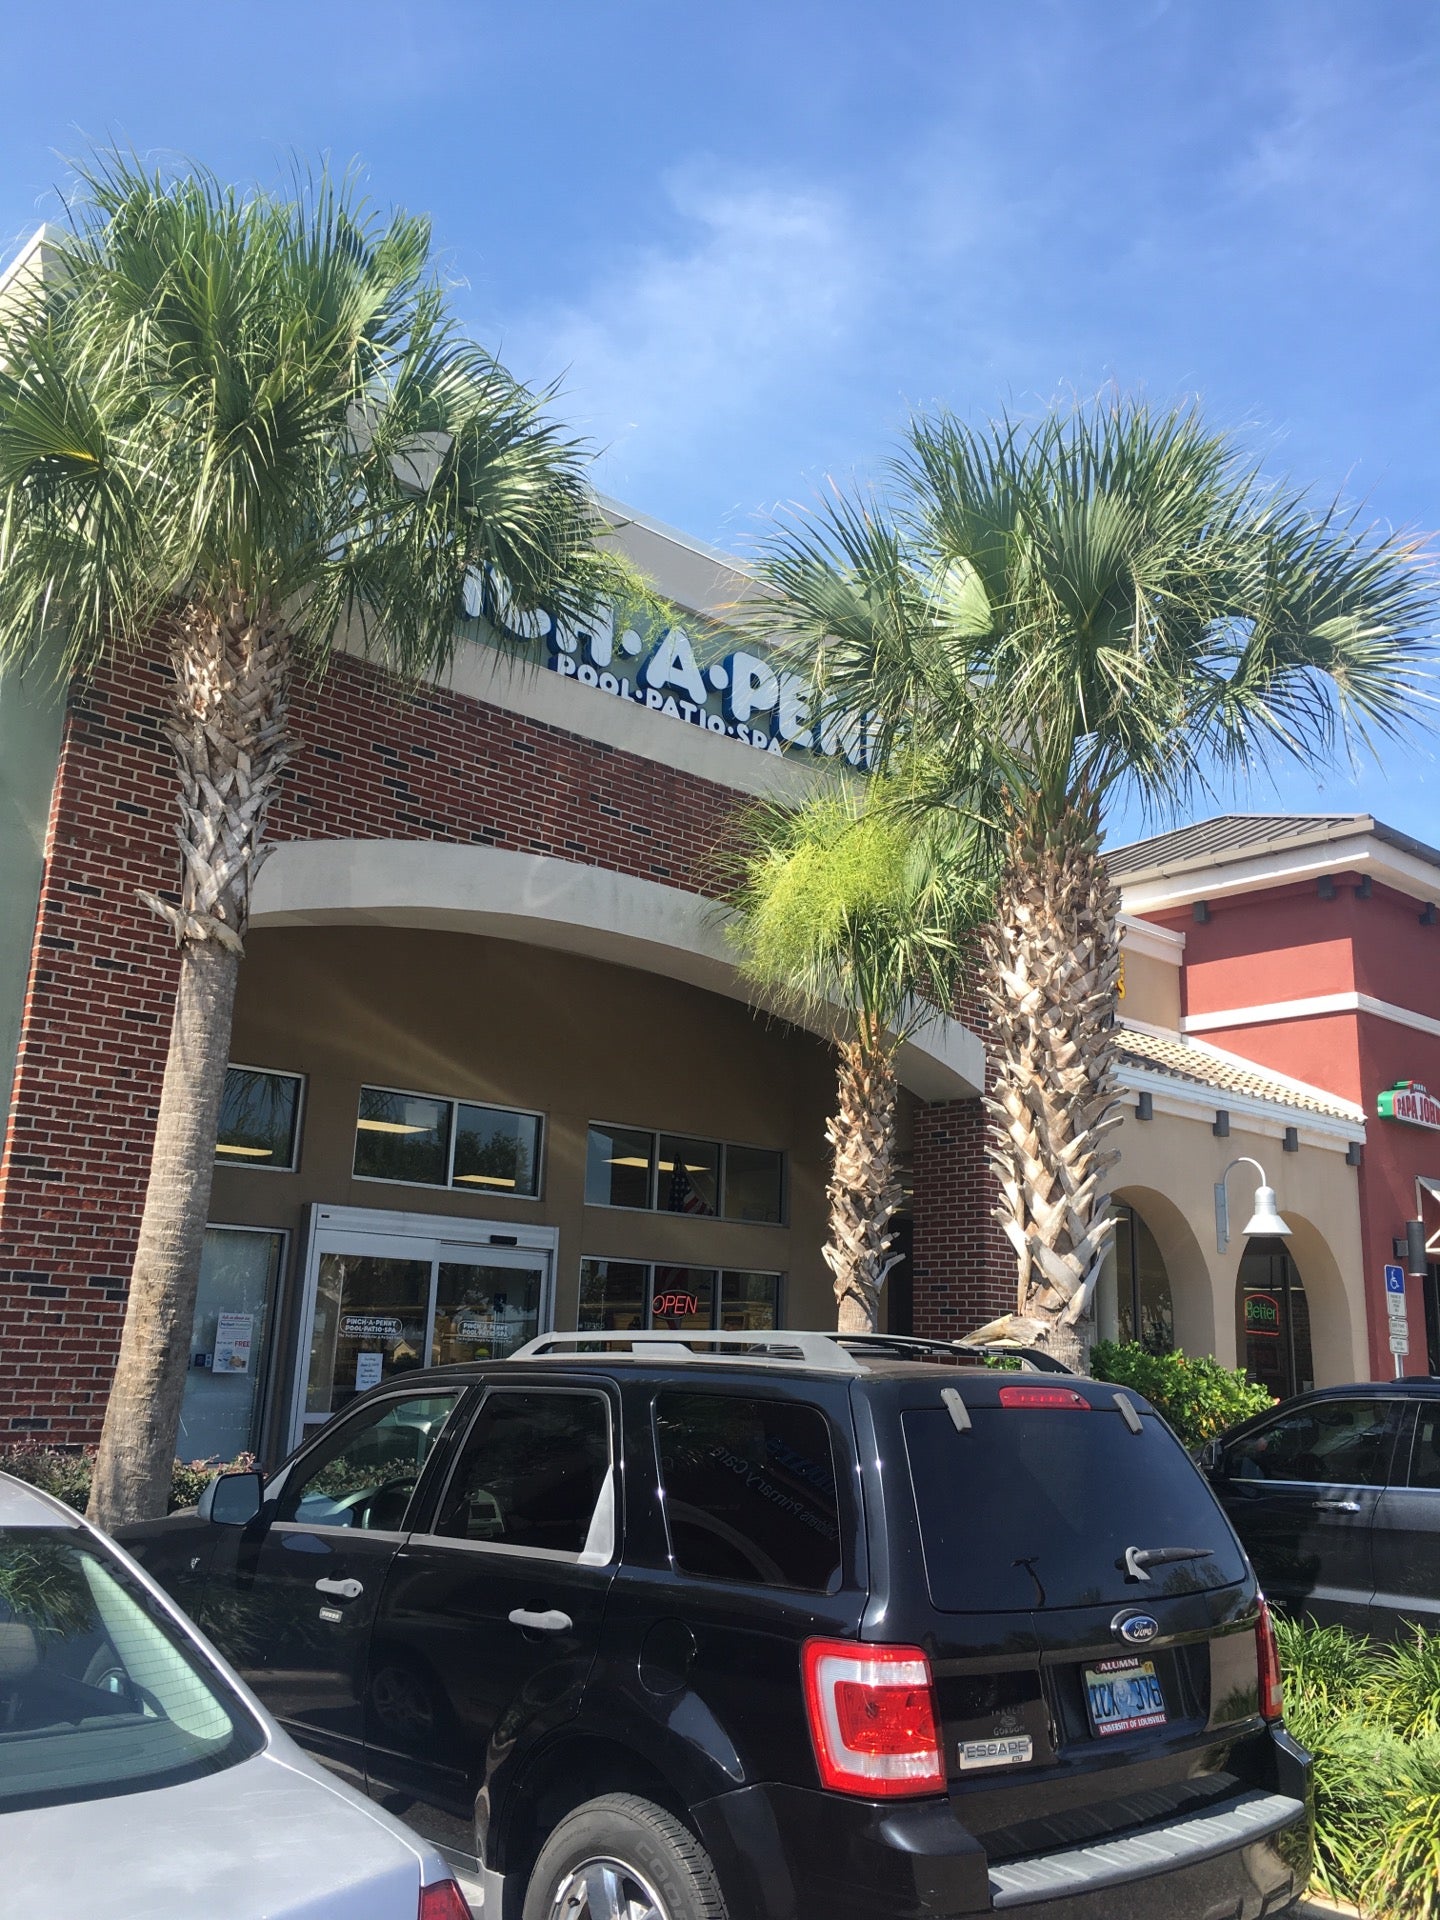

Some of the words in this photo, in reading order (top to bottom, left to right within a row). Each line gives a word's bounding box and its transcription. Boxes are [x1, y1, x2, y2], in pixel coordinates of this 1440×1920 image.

[1397, 1094, 1418, 1120] PAPA
[652, 1295, 698, 1315] OPEN
[1133, 1621, 1153, 1637] Ford
[1100, 1658, 1139, 1671] ALUMNI
[1100, 1720, 1129, 1734] UNIVERSITY
[1129, 1718, 1138, 1729] OF
[1138, 1714, 1166, 1727] LOUISVILLE
[966, 1740, 1029, 1759] ESCAPE
